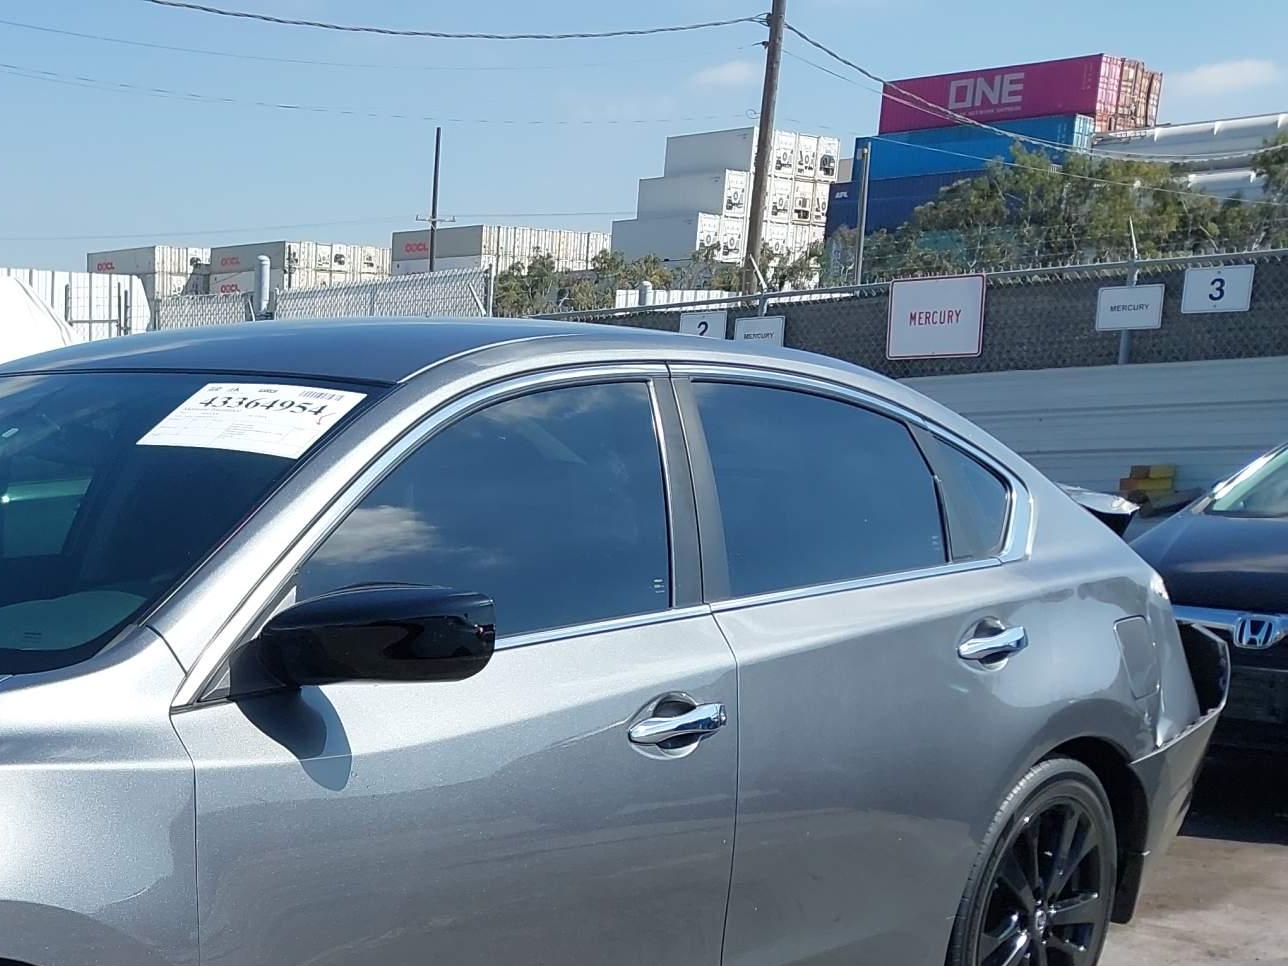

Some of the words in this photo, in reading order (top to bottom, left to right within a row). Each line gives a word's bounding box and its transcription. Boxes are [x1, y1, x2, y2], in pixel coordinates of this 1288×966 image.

[948, 72, 1025, 110] ONE
[1208, 277, 1226, 301] 3
[909, 308, 962, 327] MERCURY
[1109, 303, 1150, 313] MERCURY
[696, 320, 709, 336] 2
[743, 331, 775, 340] MERCURY
[199, 395, 329, 417] 43364954
